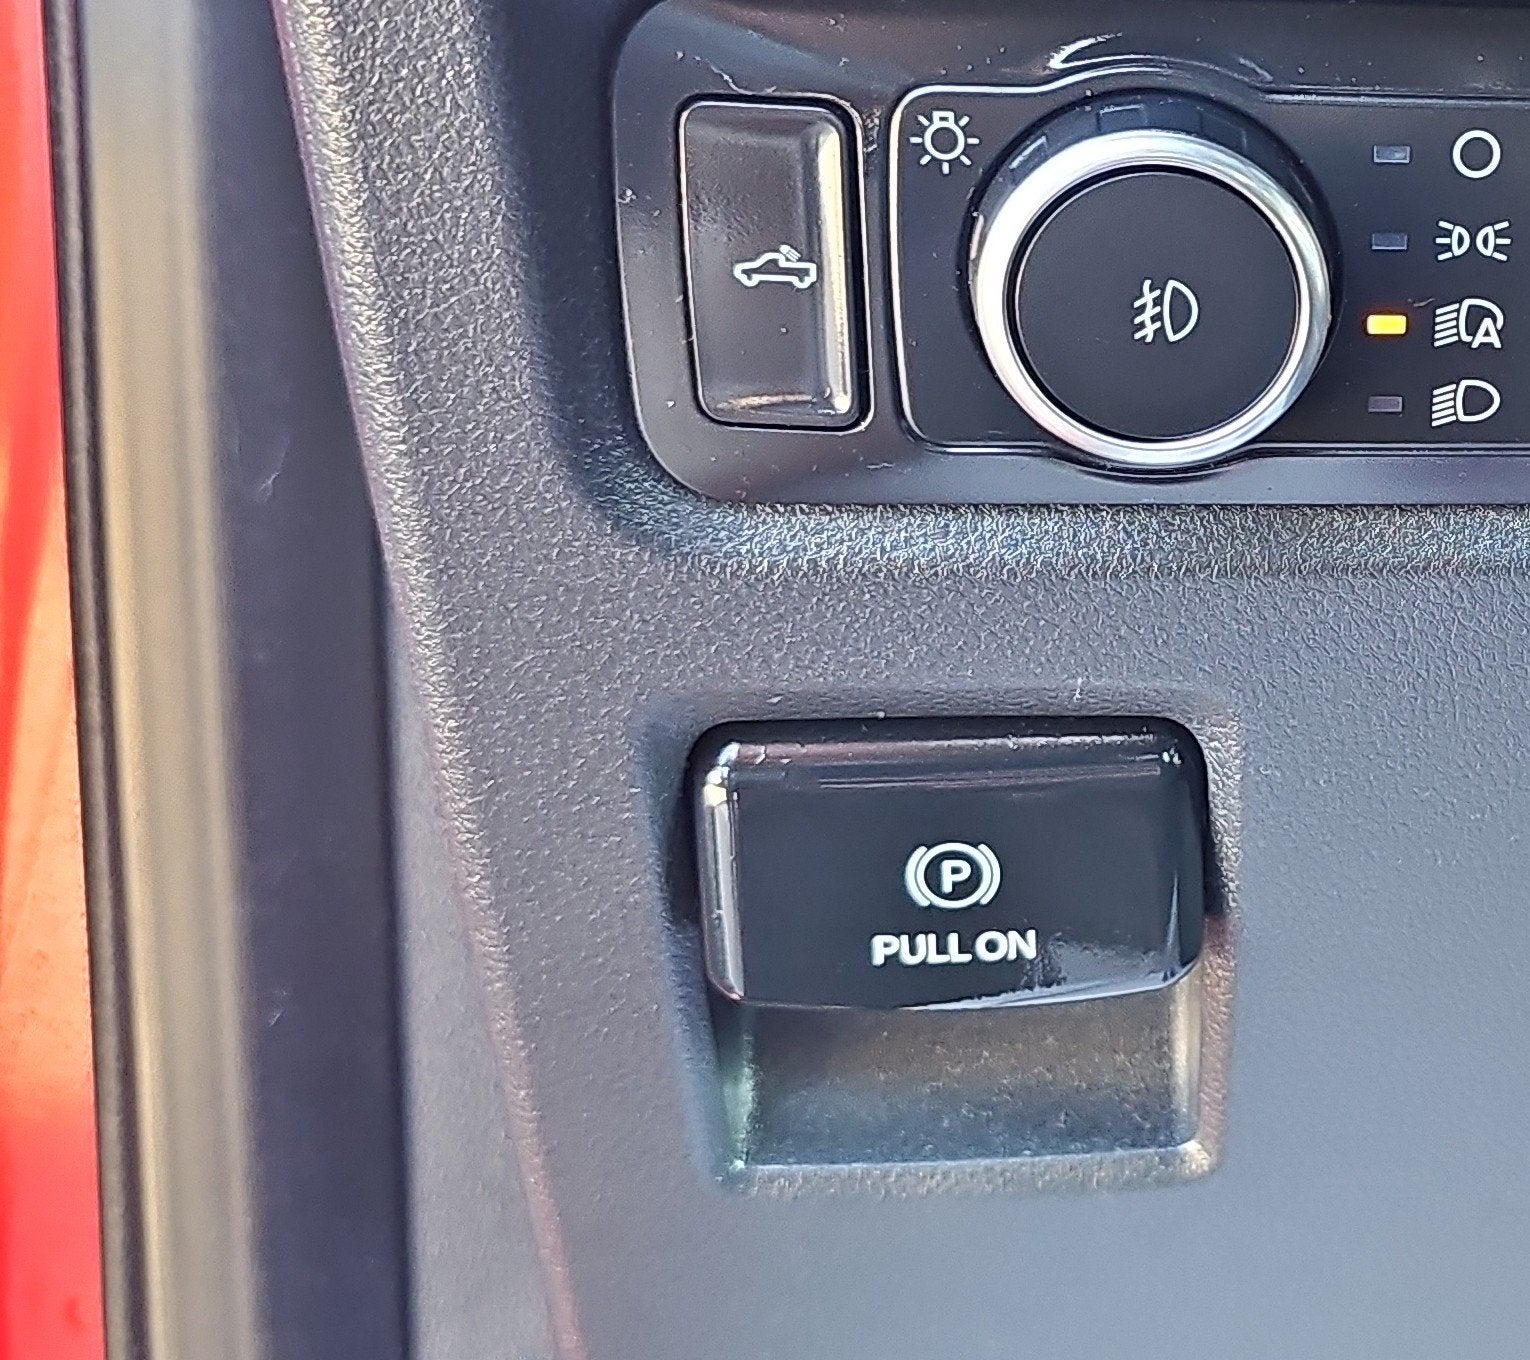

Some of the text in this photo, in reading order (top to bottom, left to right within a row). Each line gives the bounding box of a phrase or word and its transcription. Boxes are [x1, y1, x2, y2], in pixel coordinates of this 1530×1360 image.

[940, 858, 972, 895] P
[870, 928, 1038, 967] PULL ON
